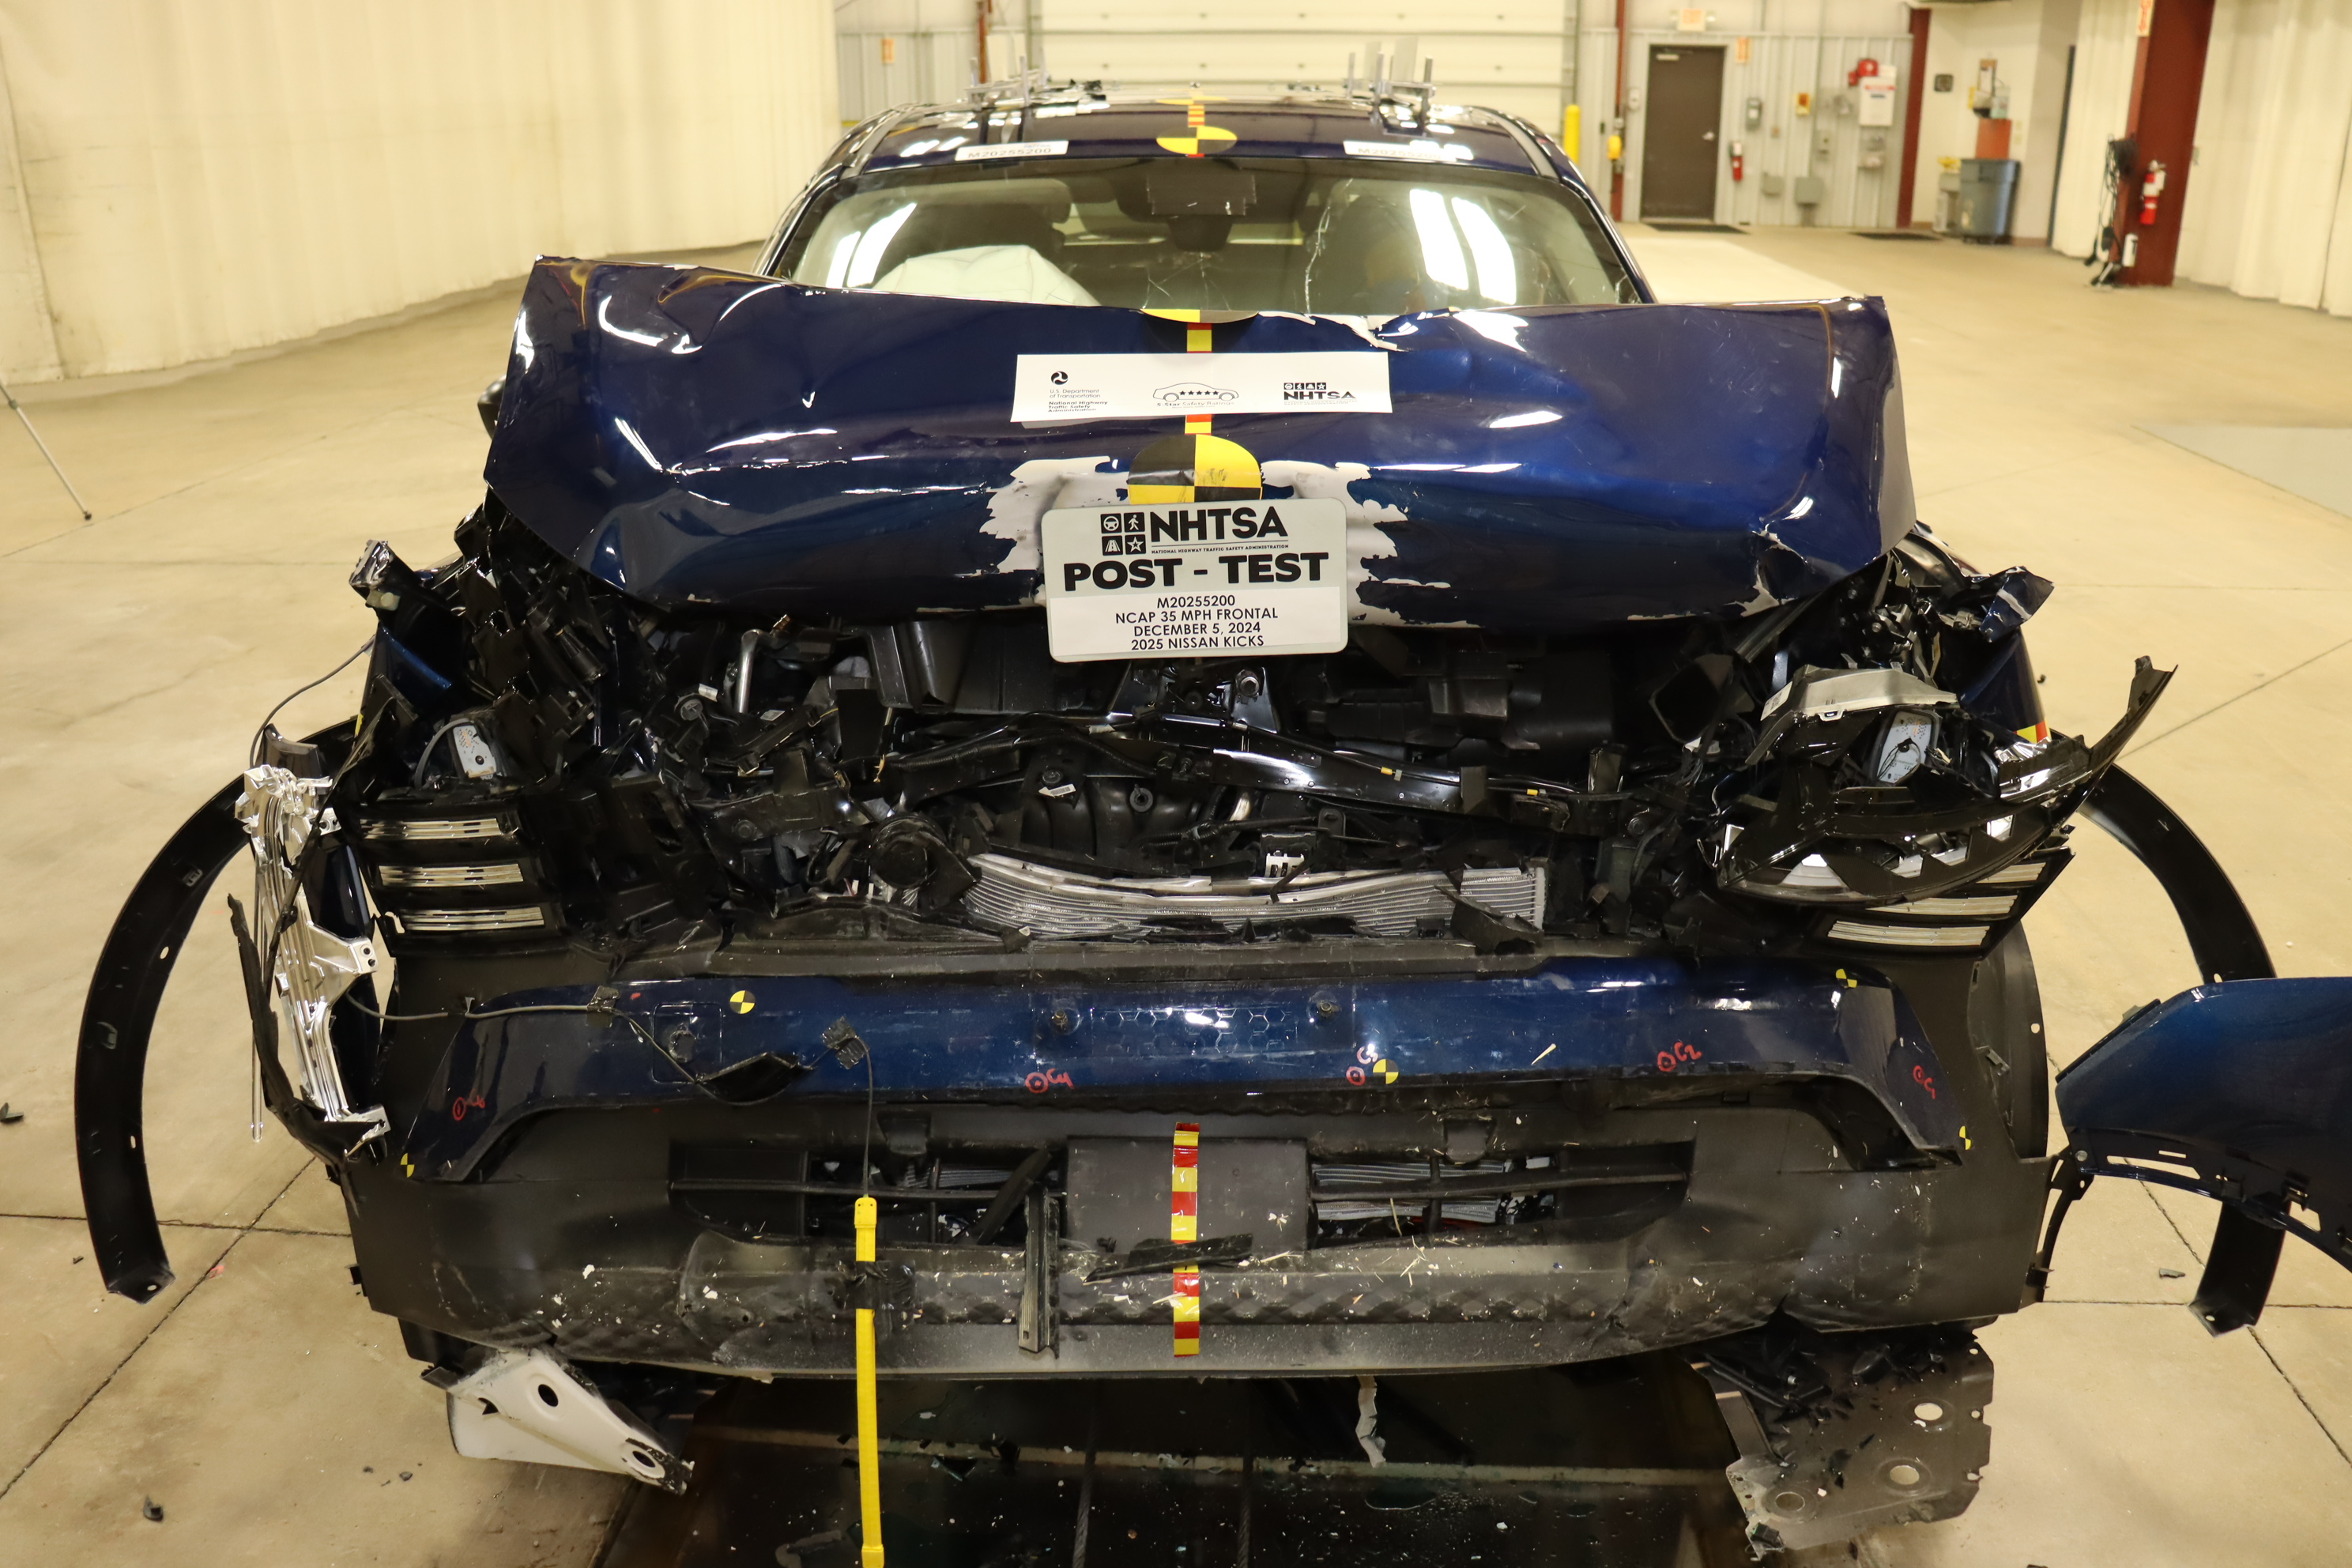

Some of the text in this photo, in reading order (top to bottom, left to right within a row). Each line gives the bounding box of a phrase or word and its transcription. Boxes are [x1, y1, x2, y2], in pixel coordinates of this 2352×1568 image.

[967, 148, 1052, 158] M20255200
[1283, 391, 1357, 400] NHTSA
[1150, 506, 1288, 543] NHTSA
[1064, 558, 1183, 592] POST
[1219, 552, 1329, 584] TEST
[1157, 595, 1235, 609] M20255200
[1115, 607, 1278, 624] NCAP 35 MPH FRONTAL
[1134, 622, 1261, 637] DECEMBER 5, 2024
[1131, 635, 1265, 650] 2025 NISSAN KICKS
